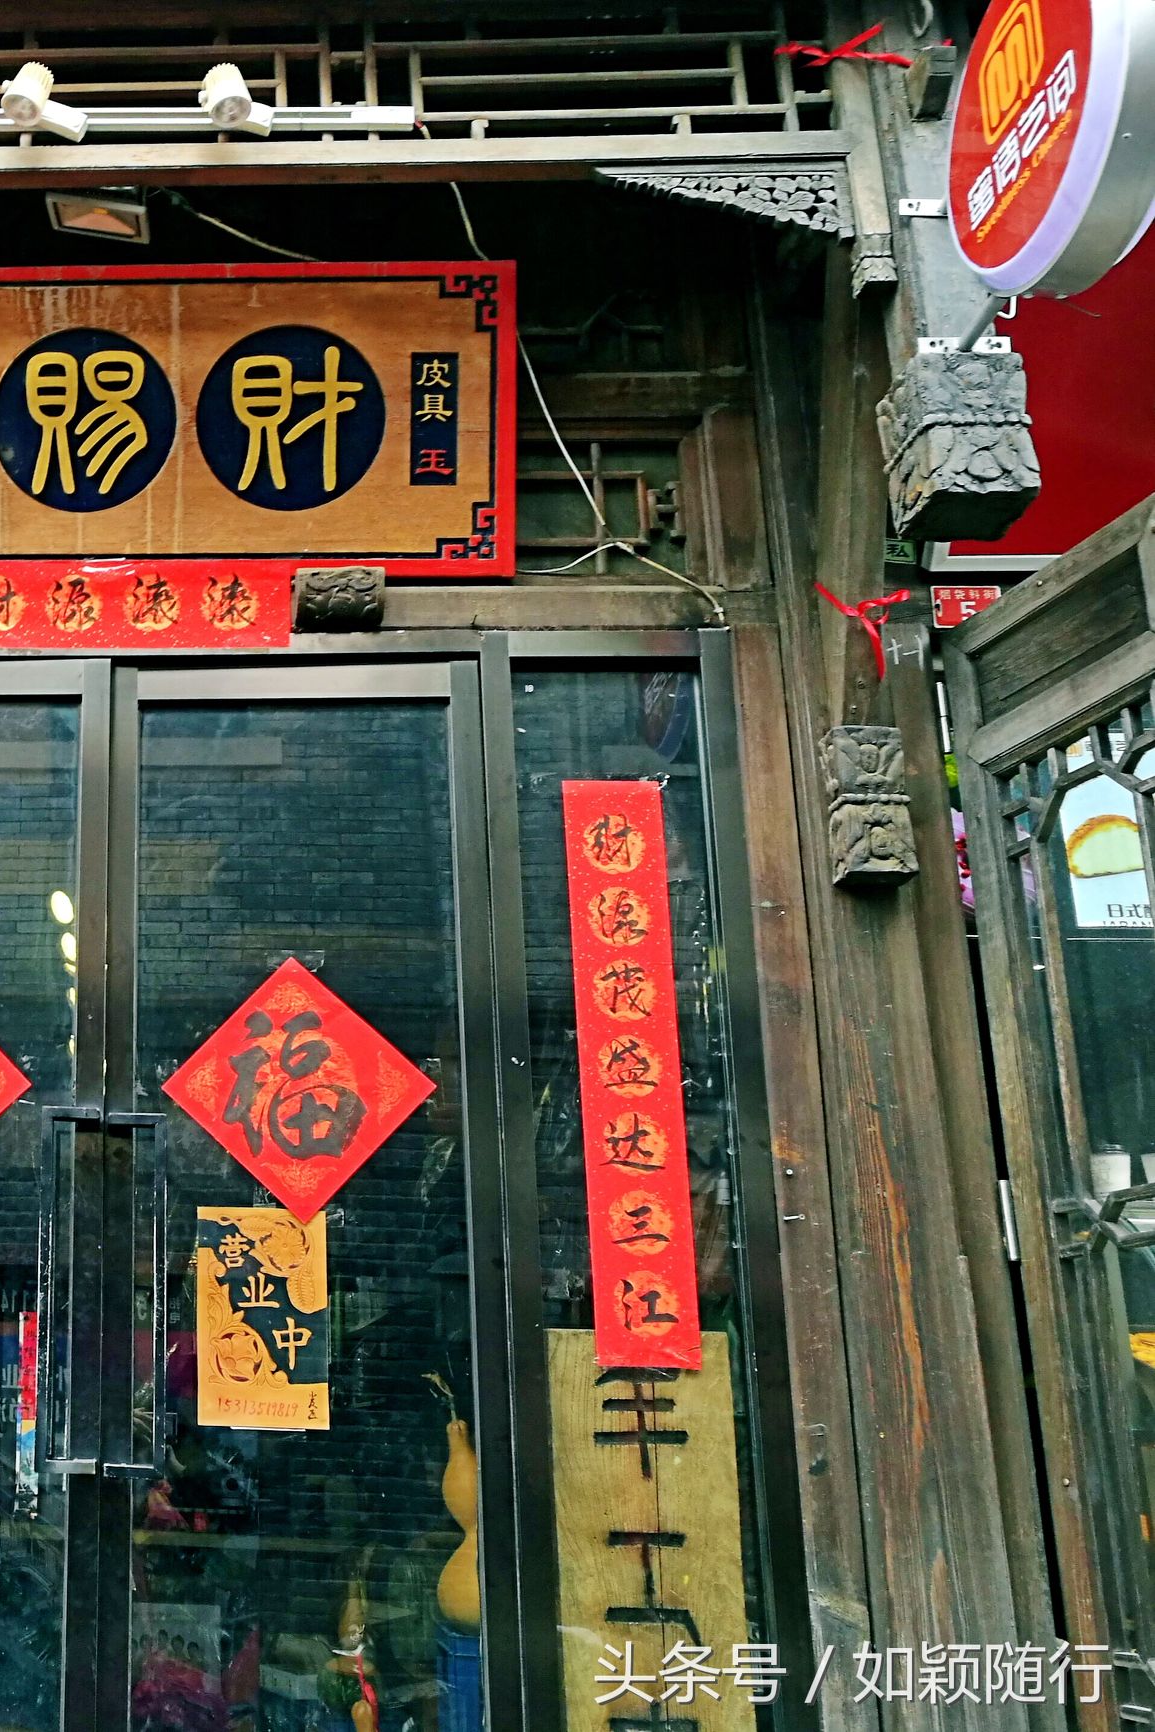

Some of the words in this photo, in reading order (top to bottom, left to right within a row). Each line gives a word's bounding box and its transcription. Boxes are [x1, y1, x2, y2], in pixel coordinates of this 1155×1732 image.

[415, 358, 454, 422] 皮具
[222, 1010, 367, 1161] 福
[219, 1232, 312, 1371] 营业中
